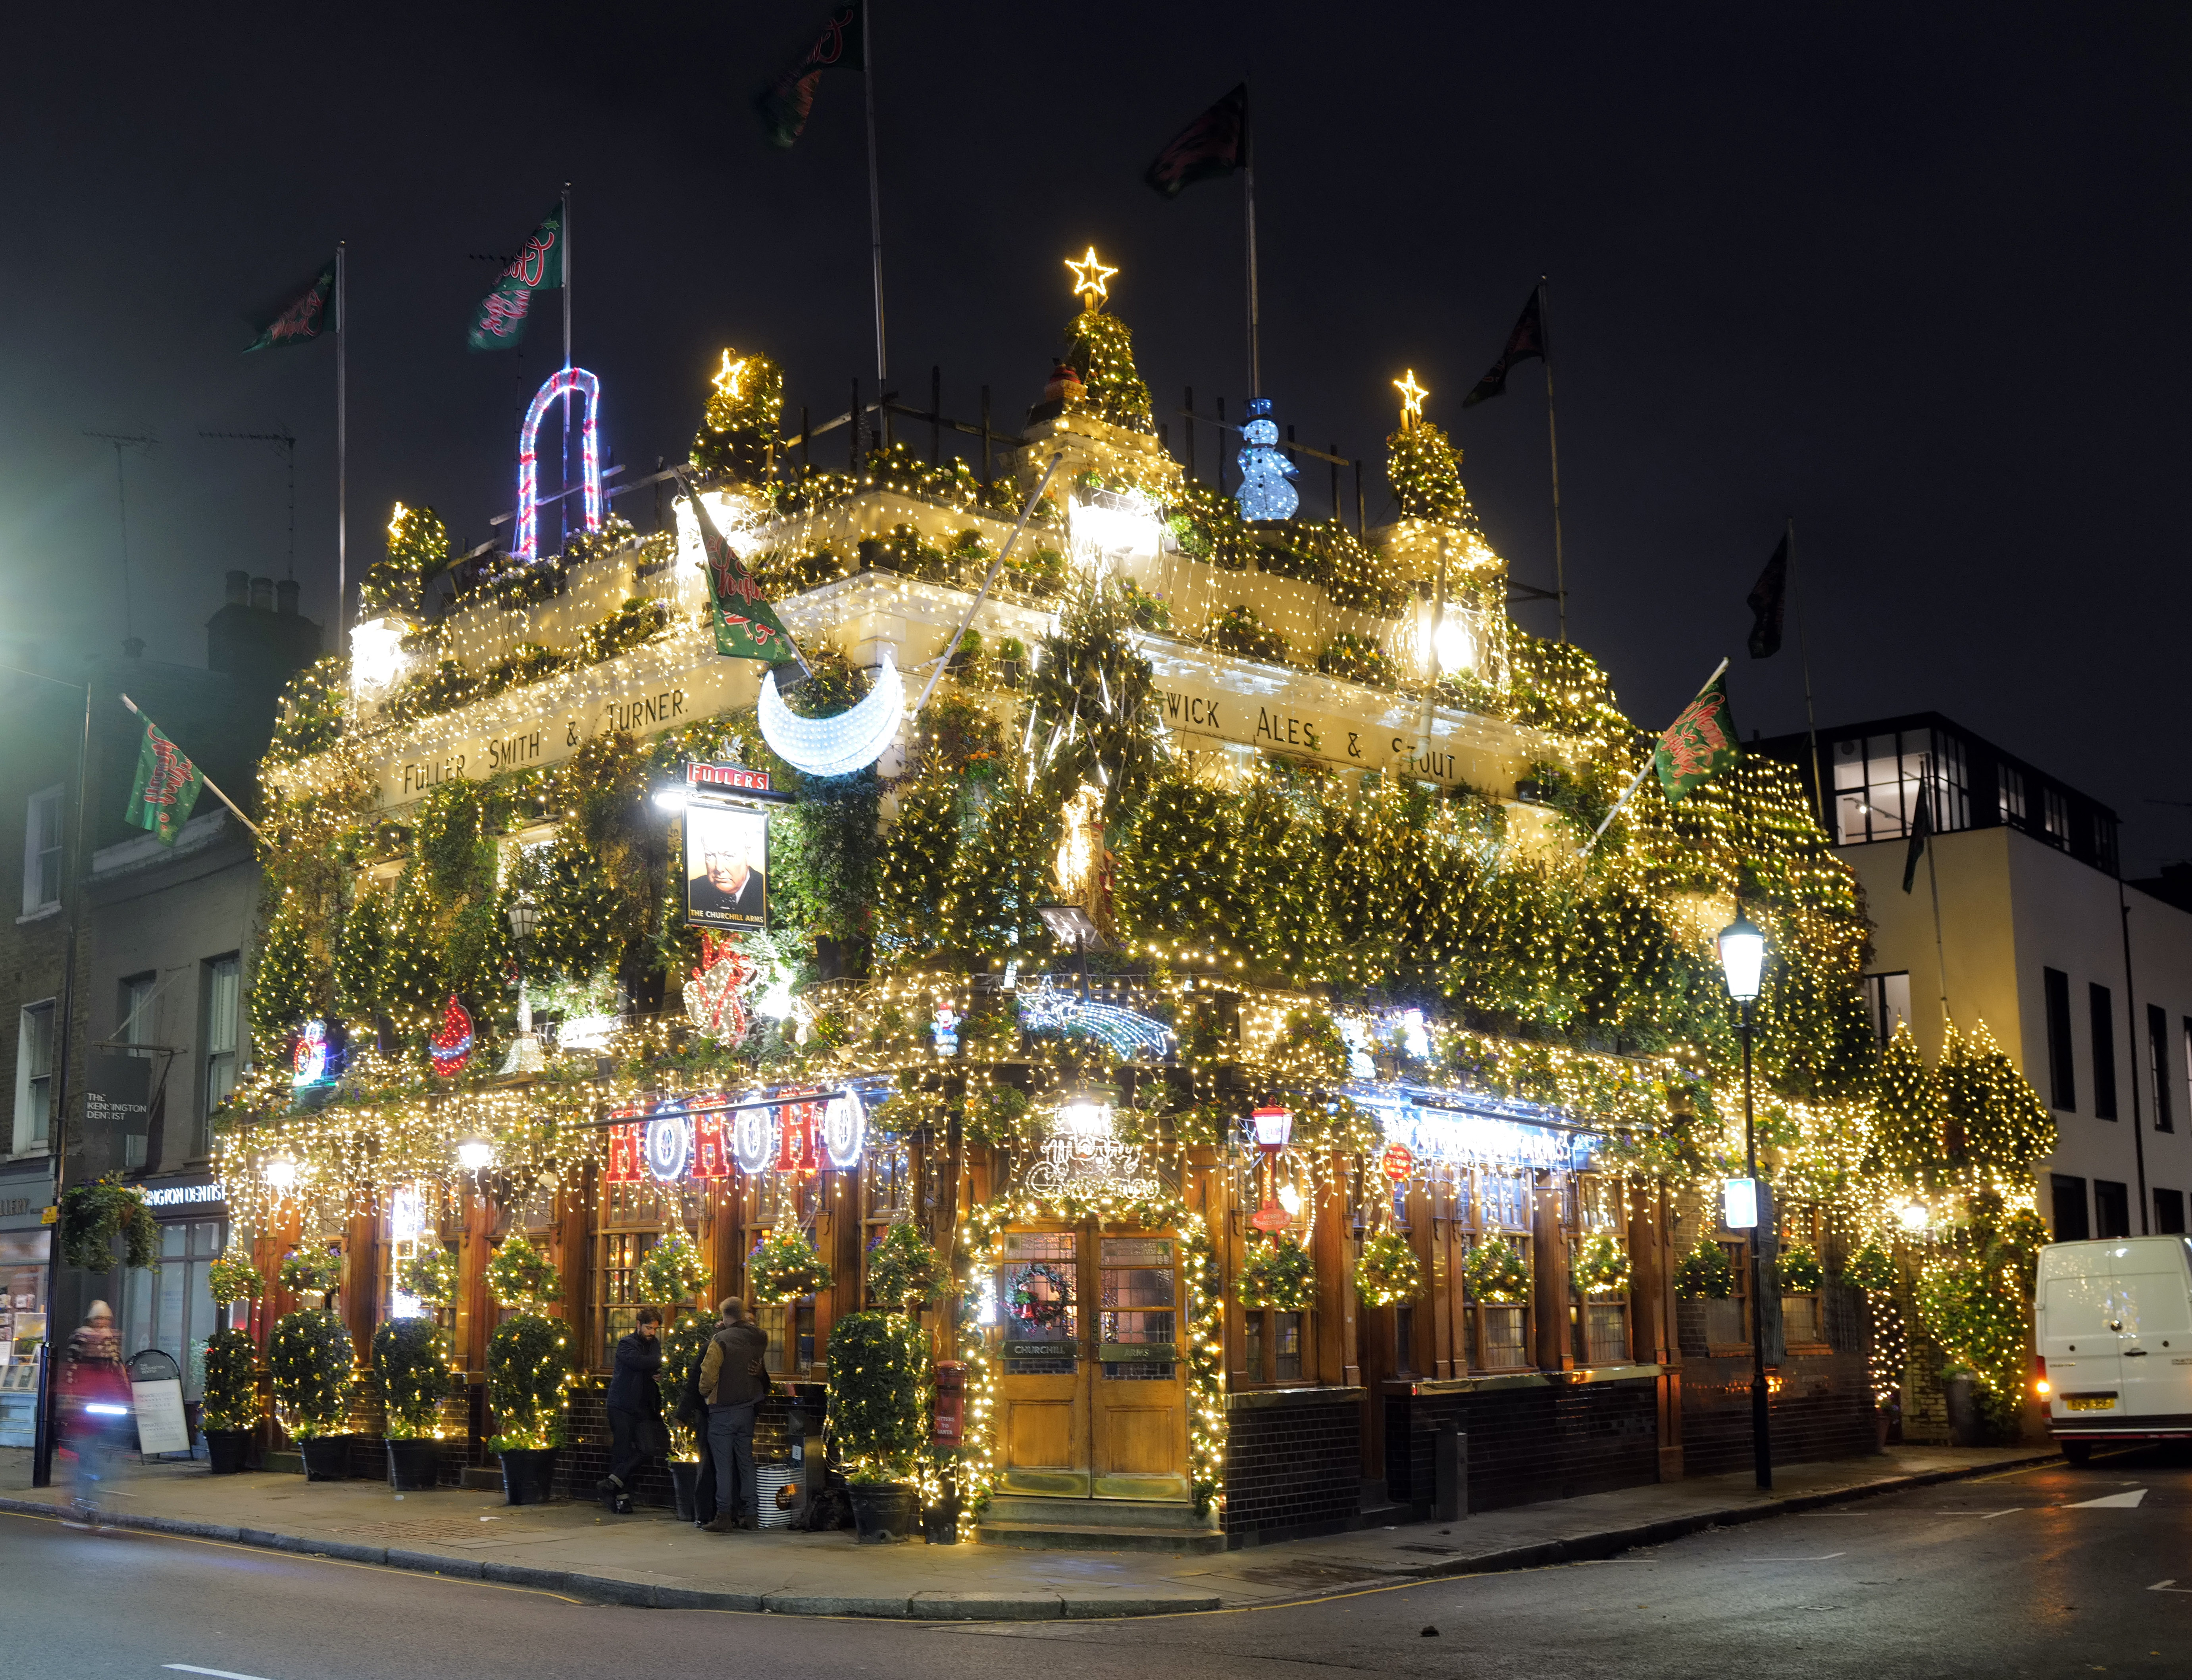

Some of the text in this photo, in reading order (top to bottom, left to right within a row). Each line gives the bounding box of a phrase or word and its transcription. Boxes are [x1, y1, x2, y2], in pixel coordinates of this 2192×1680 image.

[1256, 706, 1315, 748] ALES
[1348, 732, 1362, 759] &
[404, 754, 466, 794] FULLER
[489, 732, 541, 769] SMITH
[566, 721, 579, 748] &
[692, 764, 764, 790] FULLER'S
[690, 909, 764, 923] THE CHURCHILL ARMS
[87, 1092, 106, 1102] THE
[87, 1101, 147, 1113] KENSINGTON
[86, 1111, 126, 1121] DENTIST
[1385, 1157, 1410, 1167] STOP
[185, 1184, 225, 1203] DENTIST
[1014, 1345, 1149, 1357] CHURCHILL ARMS
